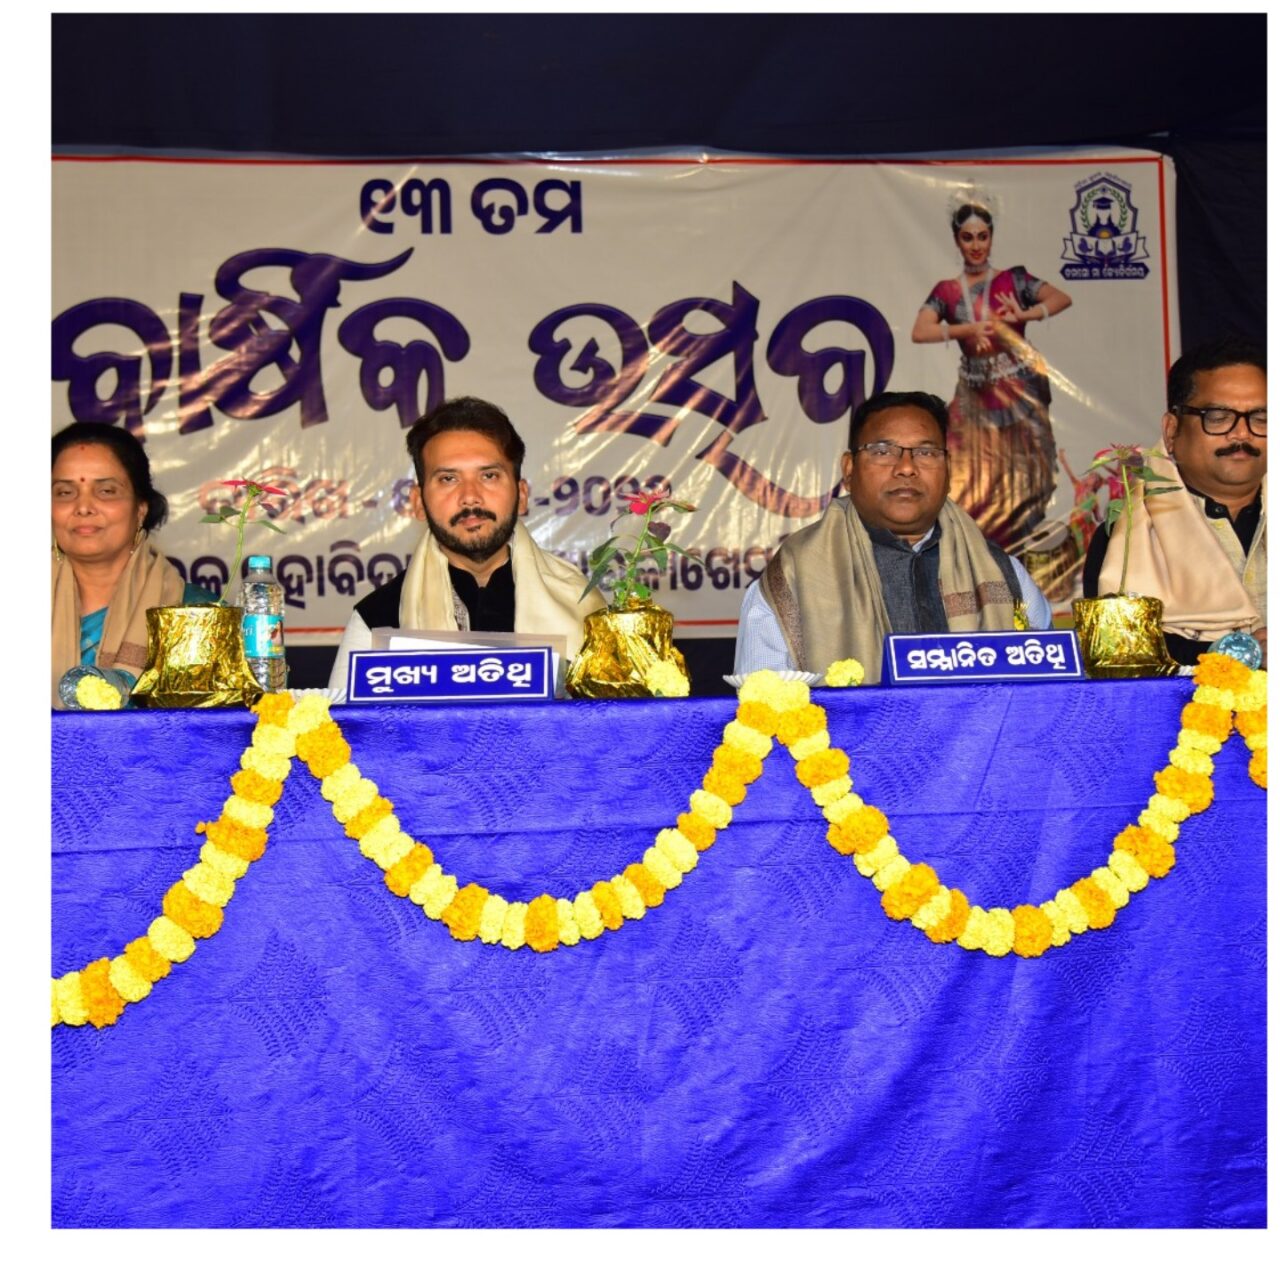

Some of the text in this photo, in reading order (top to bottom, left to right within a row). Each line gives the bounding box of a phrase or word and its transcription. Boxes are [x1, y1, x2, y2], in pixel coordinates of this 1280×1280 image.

[360, 177, 583, 236] ୧୩ ତମ
[1005, 638, 1067, 670] ଅତିଥି
[366, 657, 532, 694] ମୁଖ୍ୟ ଅତିଥି
